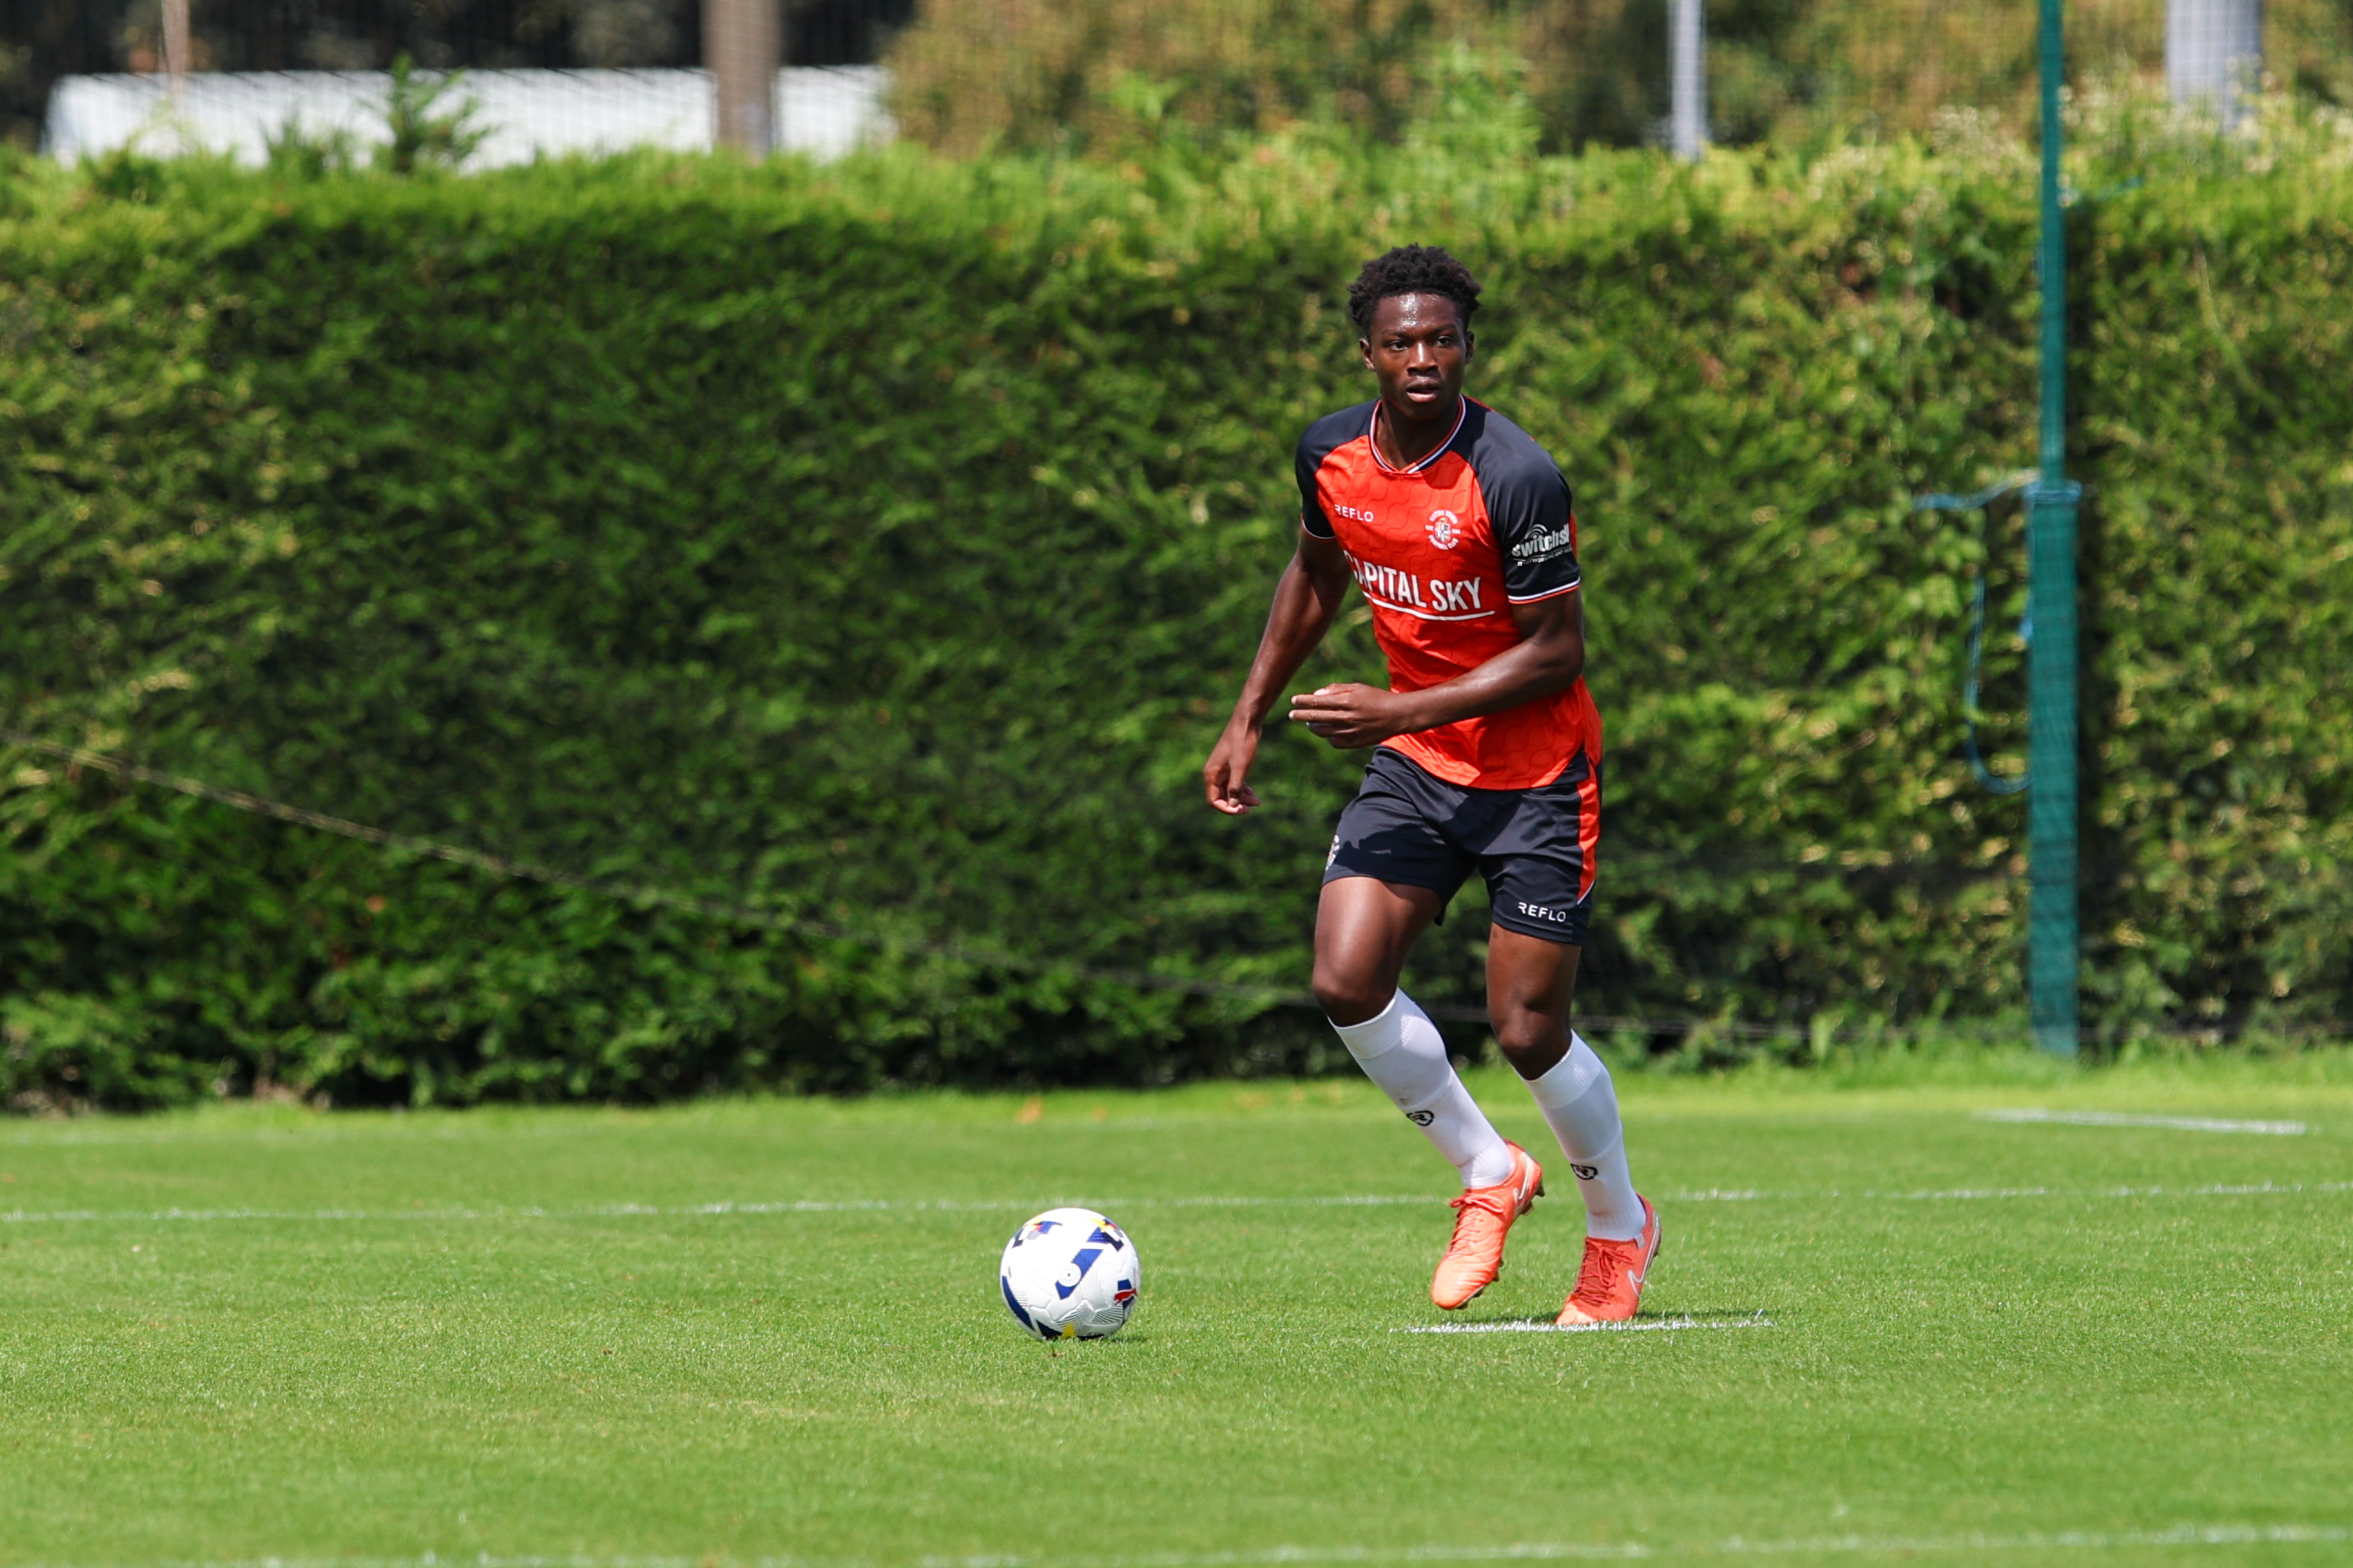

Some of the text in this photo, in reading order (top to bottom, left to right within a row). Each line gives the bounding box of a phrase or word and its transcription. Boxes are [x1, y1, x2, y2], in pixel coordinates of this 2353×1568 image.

[1335, 504, 1374, 522] REFLO
[1430, 576, 1481, 611] SKY
[1518, 901, 1566, 922] REFLO
